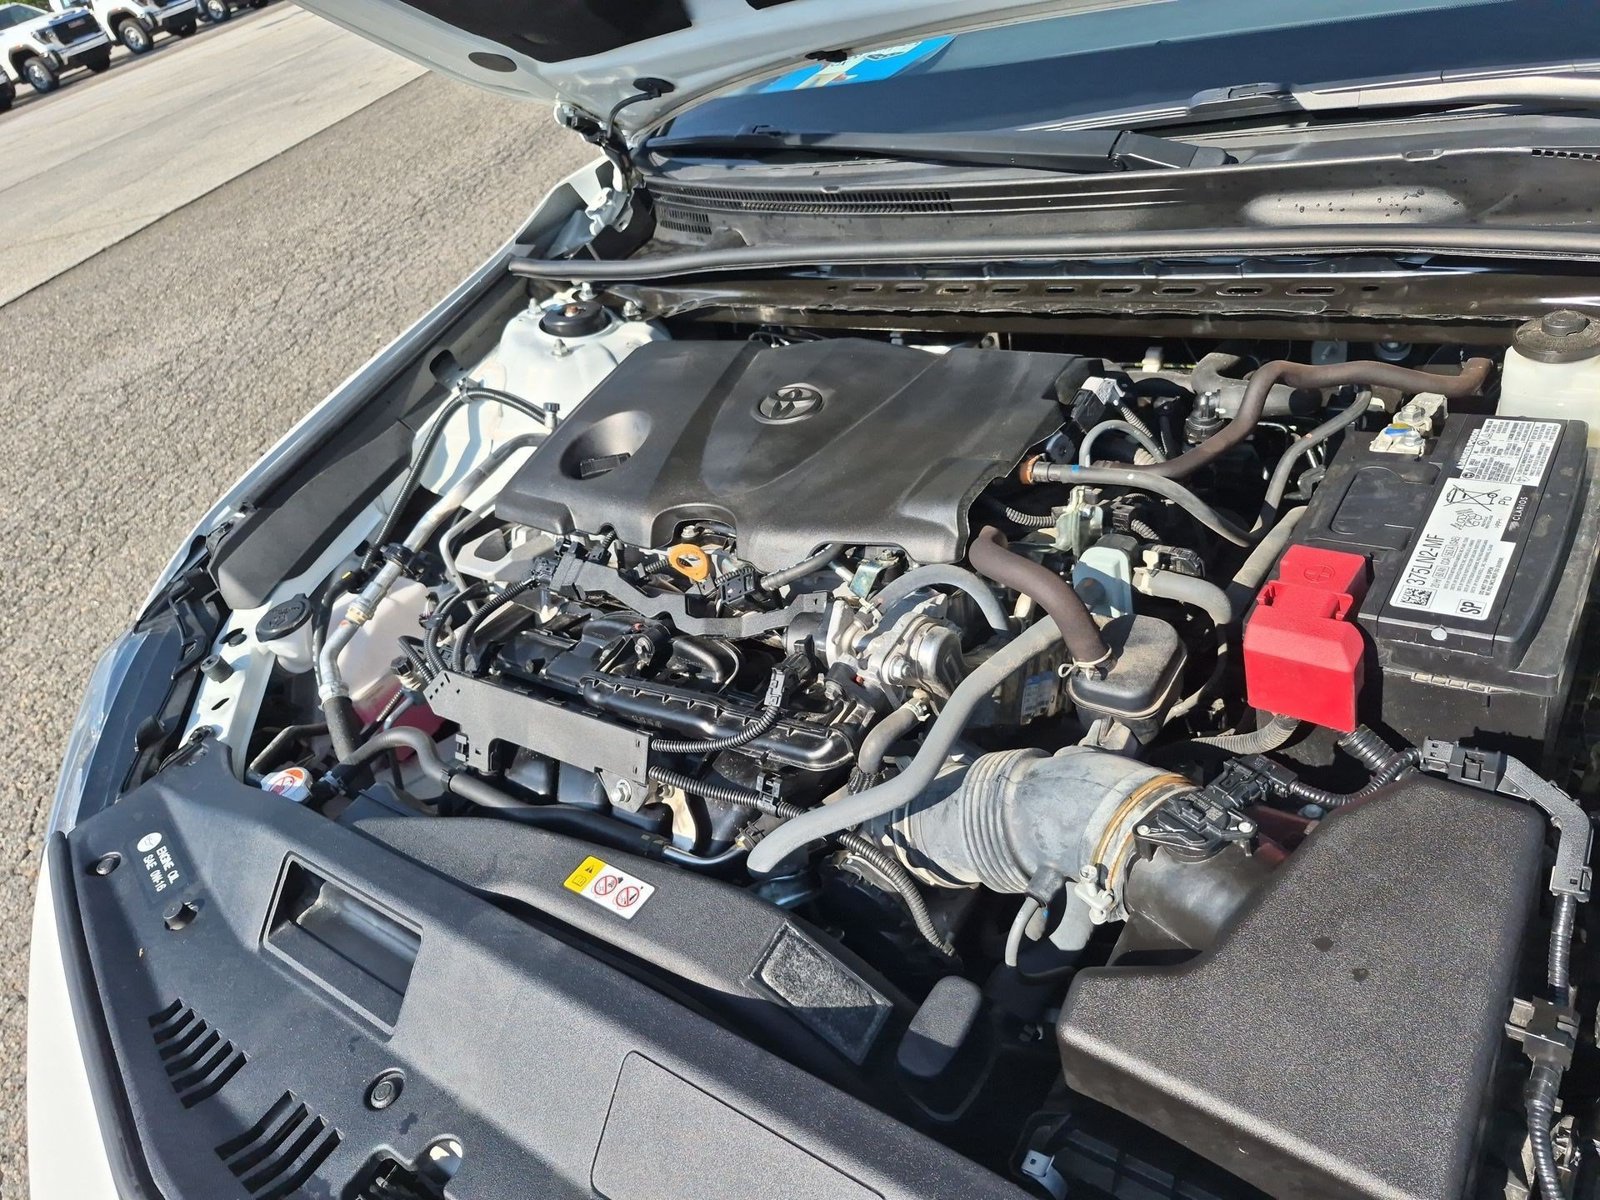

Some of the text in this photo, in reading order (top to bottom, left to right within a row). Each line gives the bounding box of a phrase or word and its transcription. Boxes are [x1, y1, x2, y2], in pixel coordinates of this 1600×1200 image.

[1512, 496, 1528, 521] CLARIOS
[1406, 534, 1445, 586] 375LN2-MF
[1460, 602, 1481, 615] SP
[143, 853, 167, 892] SAE 0W-16
[156, 845, 180, 884] ENGINE OIL
